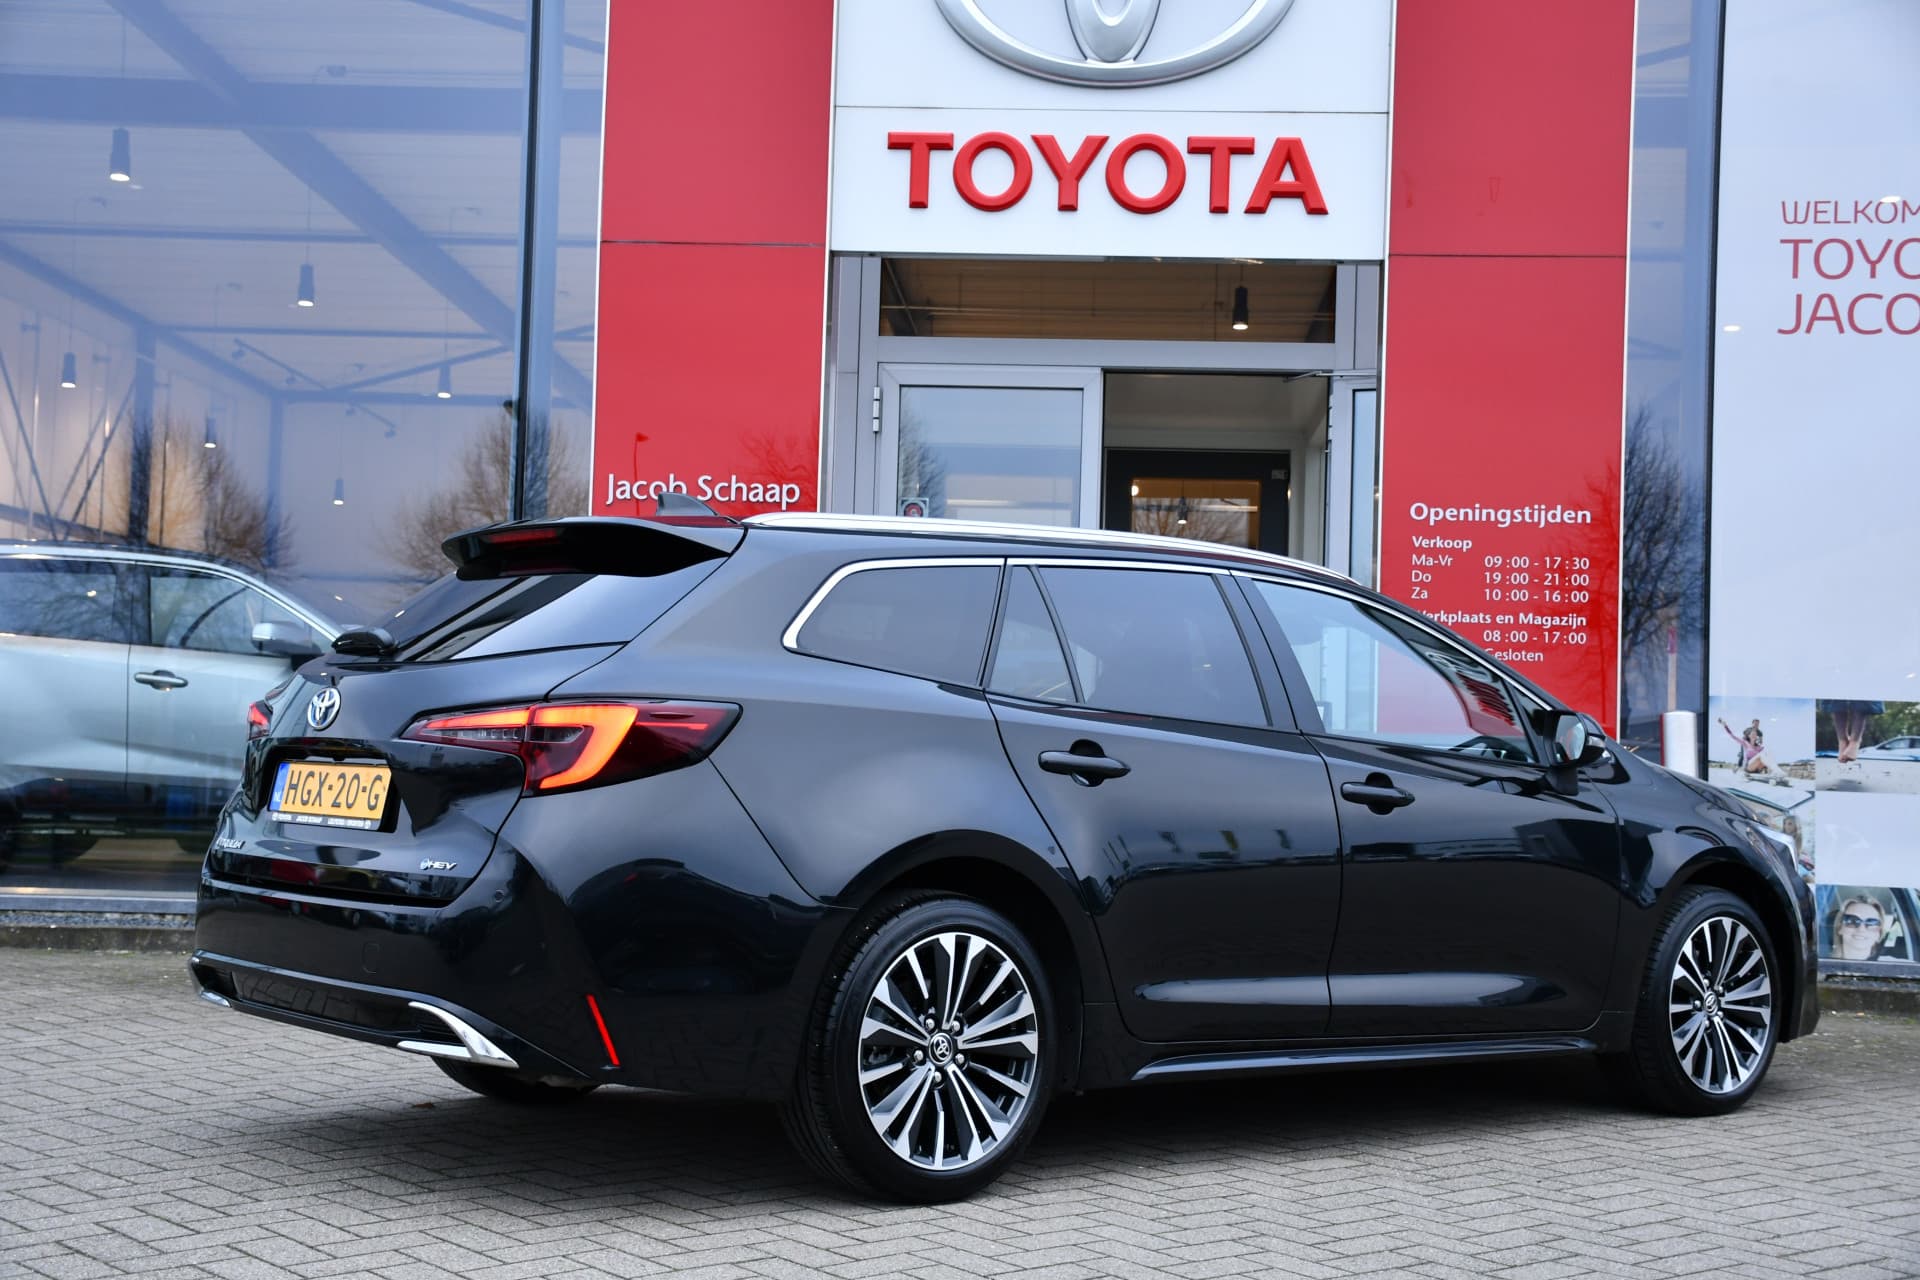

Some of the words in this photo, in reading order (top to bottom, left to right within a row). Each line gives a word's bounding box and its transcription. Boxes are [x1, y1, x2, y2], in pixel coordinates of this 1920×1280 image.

[887, 131, 1329, 215] TOYOTA
[1781, 200, 1920, 225] WELKOM
[1779, 237, 1920, 280] TOYO
[1777, 292, 1920, 336] JACO
[605, 473, 688, 506] Jacob
[696, 474, 801, 511] Schaap
[1409, 502, 1592, 528] Openingstijden
[1411, 536, 1473, 552] Verkoop
[1411, 554, 1453, 567] Ma-Vr
[1411, 570, 1432, 583] Do
[1410, 587, 1428, 600] Za
[1418, 610, 1492, 626] erkplaats
[1495, 615, 1514, 625] en
[1518, 612, 1587, 629] Magazijn
[284, 769, 383, 811] HGX-20-G
